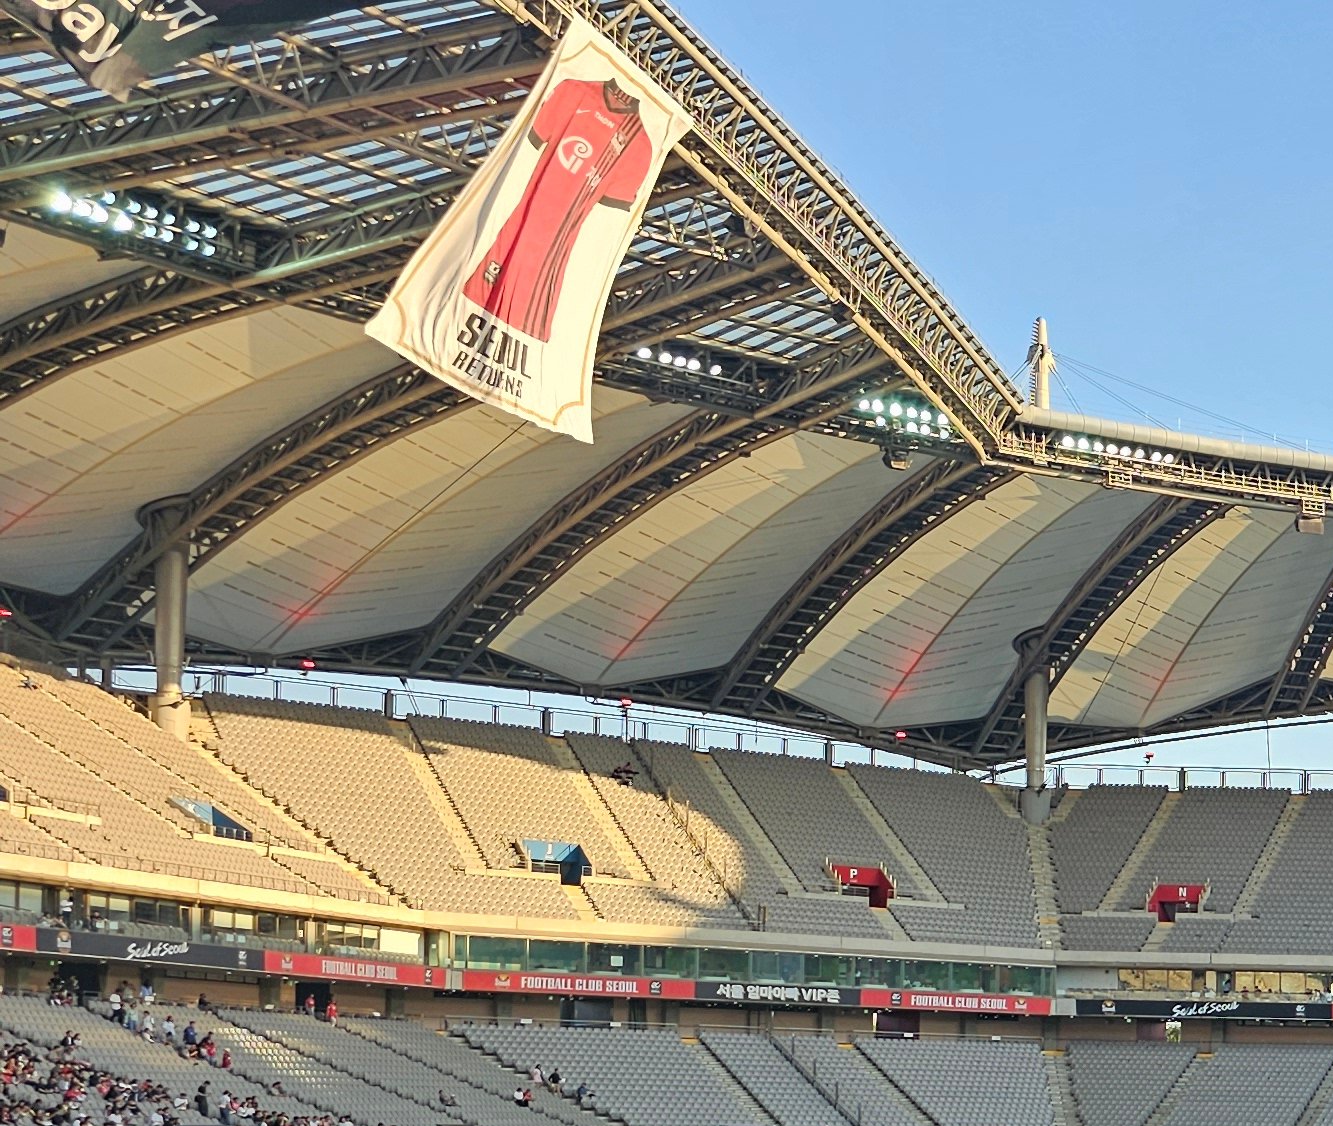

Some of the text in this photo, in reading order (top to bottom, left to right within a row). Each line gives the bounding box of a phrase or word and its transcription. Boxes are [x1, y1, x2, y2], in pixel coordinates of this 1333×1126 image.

[457, 311, 532, 379] SEOUL
[850, 868, 858, 879] P
[1179, 887, 1187, 897] N
[321, 960, 356, 977] FOOTBALL
[374, 965, 397, 980] SEOUL
[520, 976, 639, 993] FOOTBALL CLUB SEOUL
[716, 984, 745, 1000] 서울
[910, 995, 1008, 1010] FOOTBALL CLUB SEOUL
